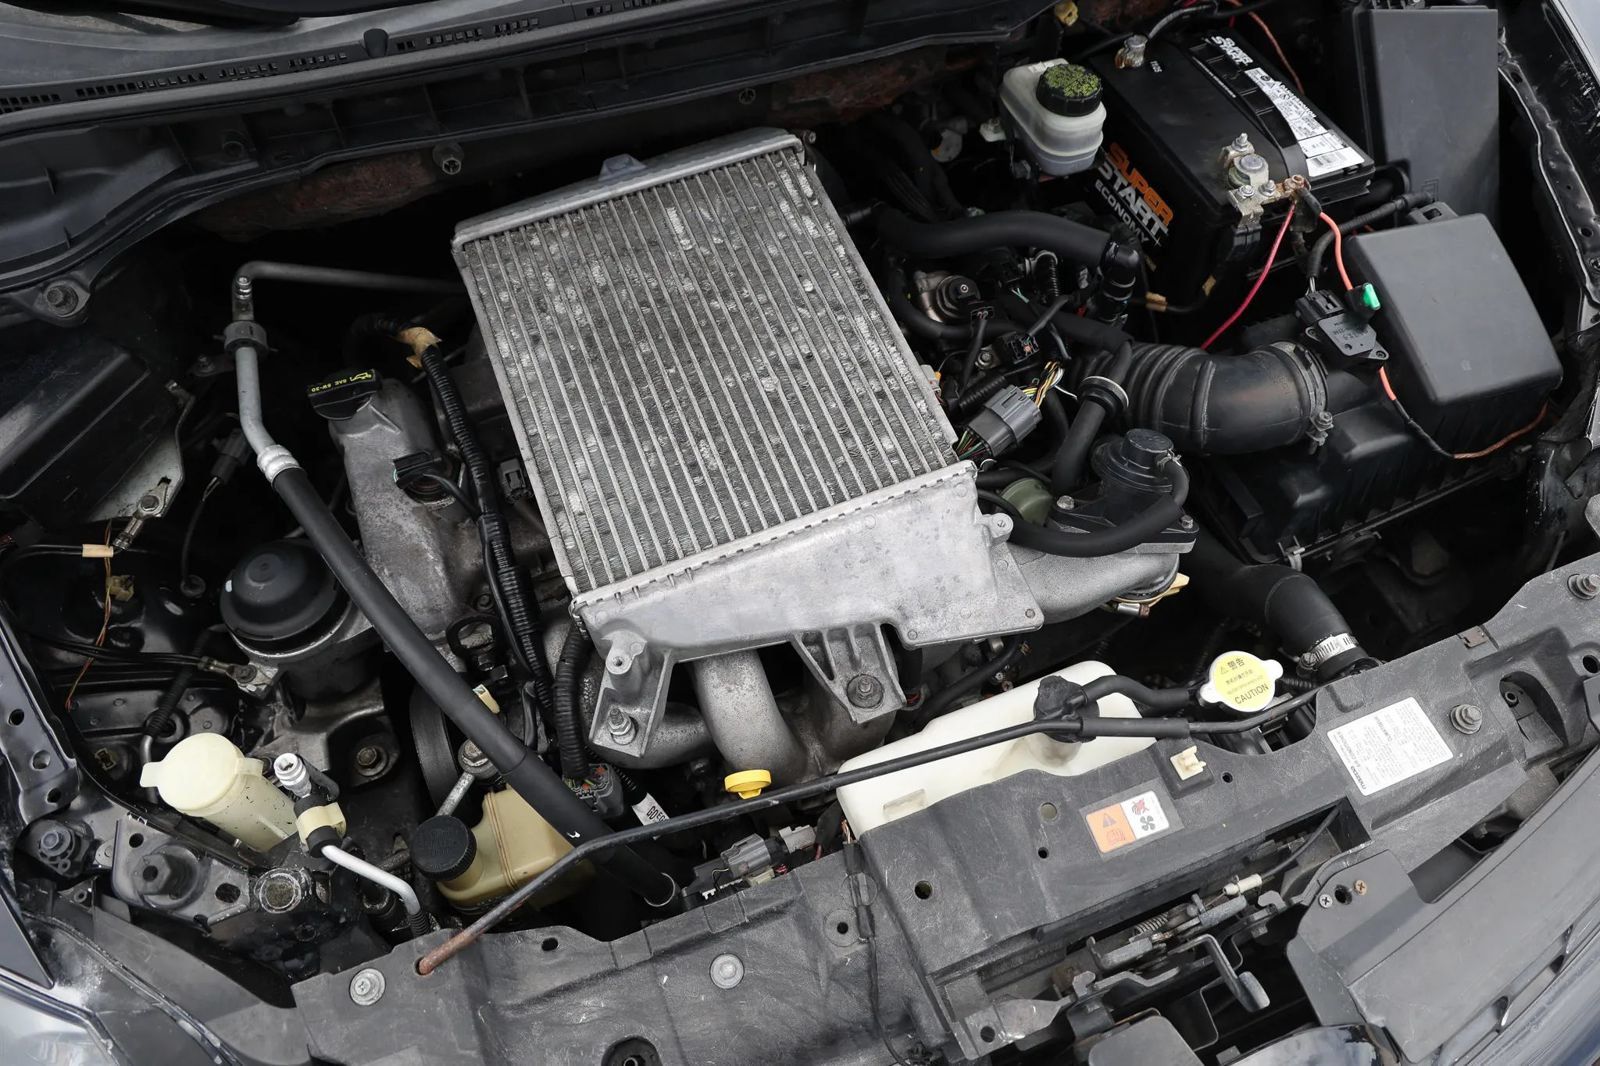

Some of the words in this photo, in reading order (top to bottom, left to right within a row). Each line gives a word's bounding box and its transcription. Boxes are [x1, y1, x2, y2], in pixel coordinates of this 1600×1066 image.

[1095, 179, 1149, 243] ECONOMY
[1098, 153, 1169, 235] START
[1106, 142, 1173, 226] SUPER
[1234, 683, 1269, 705] CAUTION
